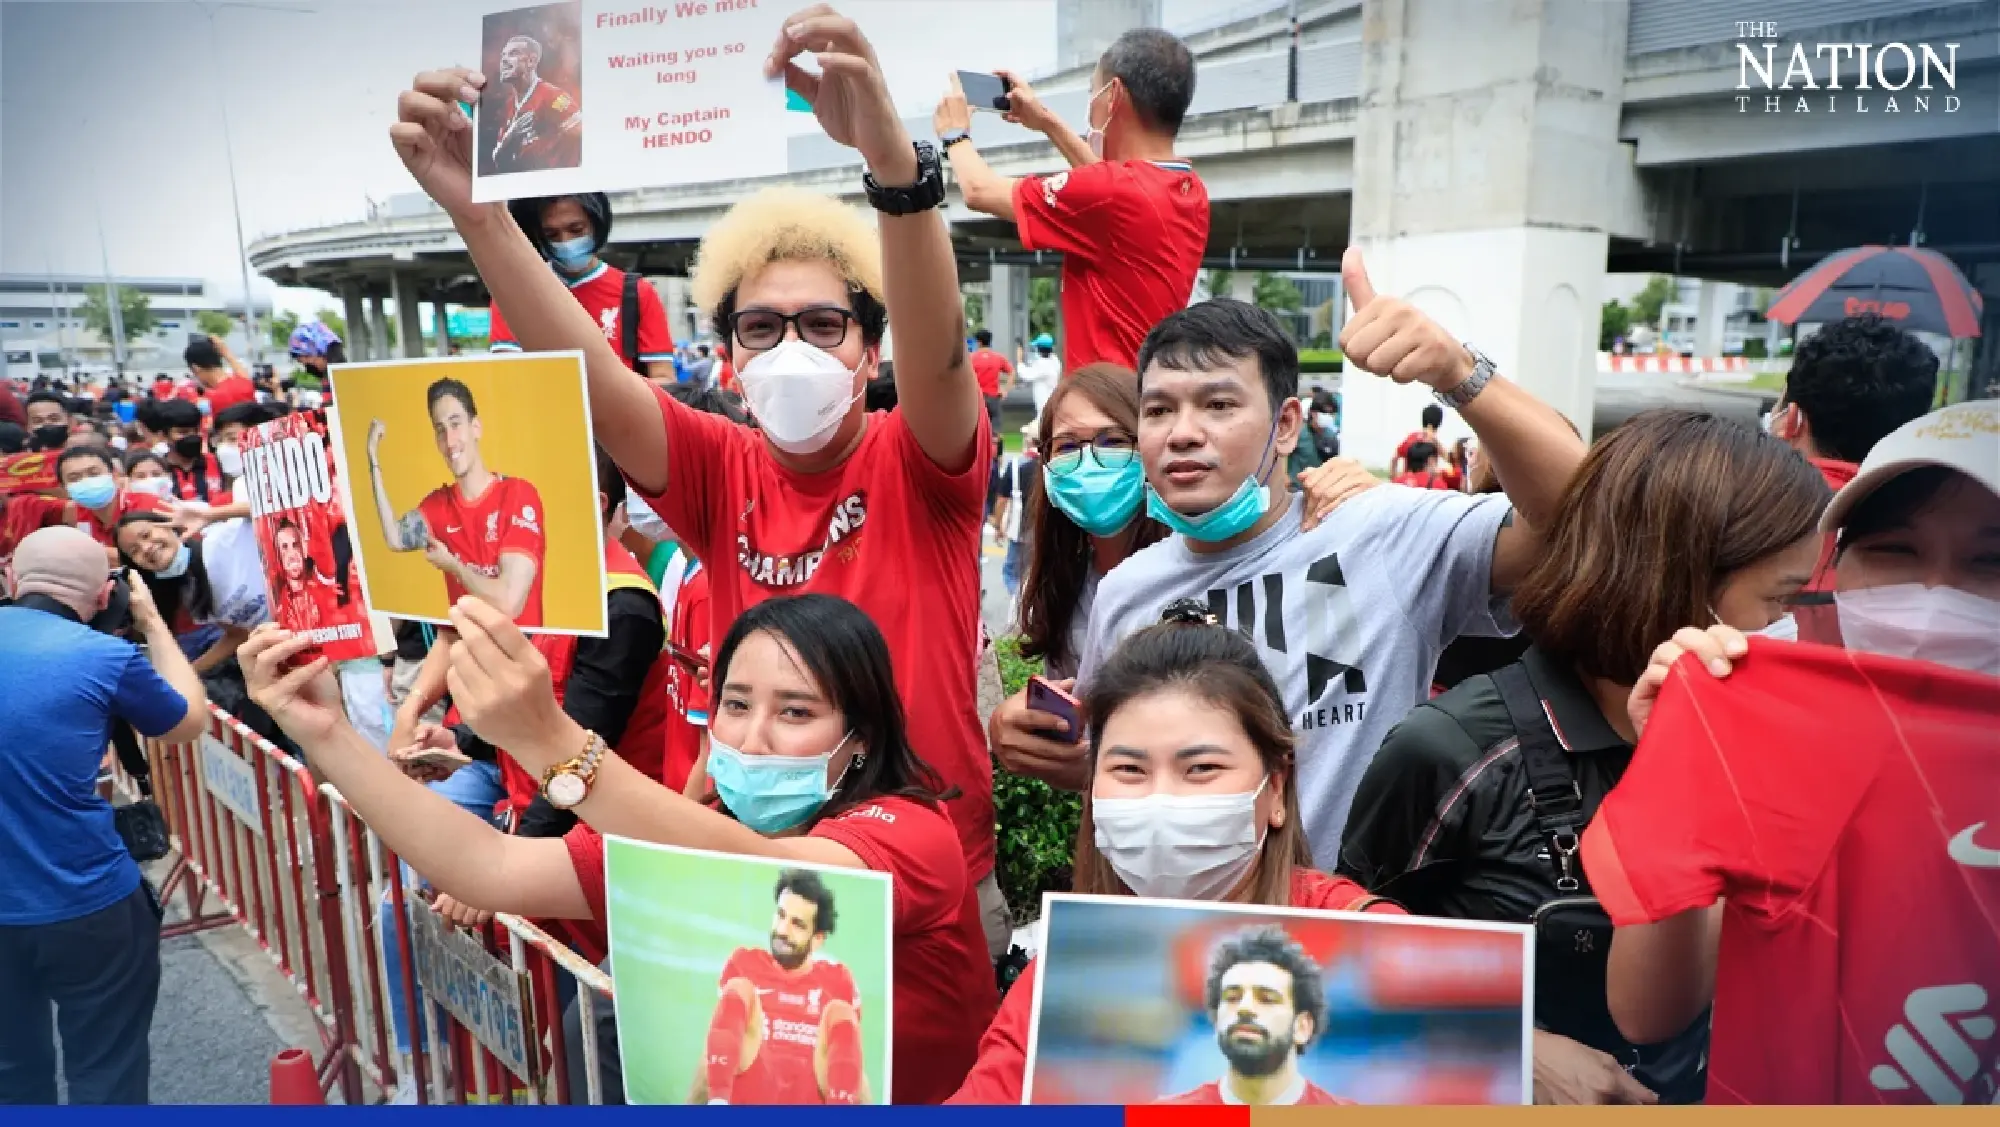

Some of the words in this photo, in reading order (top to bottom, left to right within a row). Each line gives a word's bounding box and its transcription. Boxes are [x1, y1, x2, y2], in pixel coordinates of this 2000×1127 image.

[596, 7, 668, 28] Finally
[675, 2, 708, 18] We
[608, 51, 678, 69] Waiting
[685, 47, 718, 62] you
[723, 42, 746, 54] so
[657, 69, 697, 84] long
[624, 116, 651, 132] My
[657, 107, 731, 127] Captain
[643, 128, 713, 148] HENDO
[241, 431, 331, 518] HENDO
[1302, 702, 1366, 730] HEART
